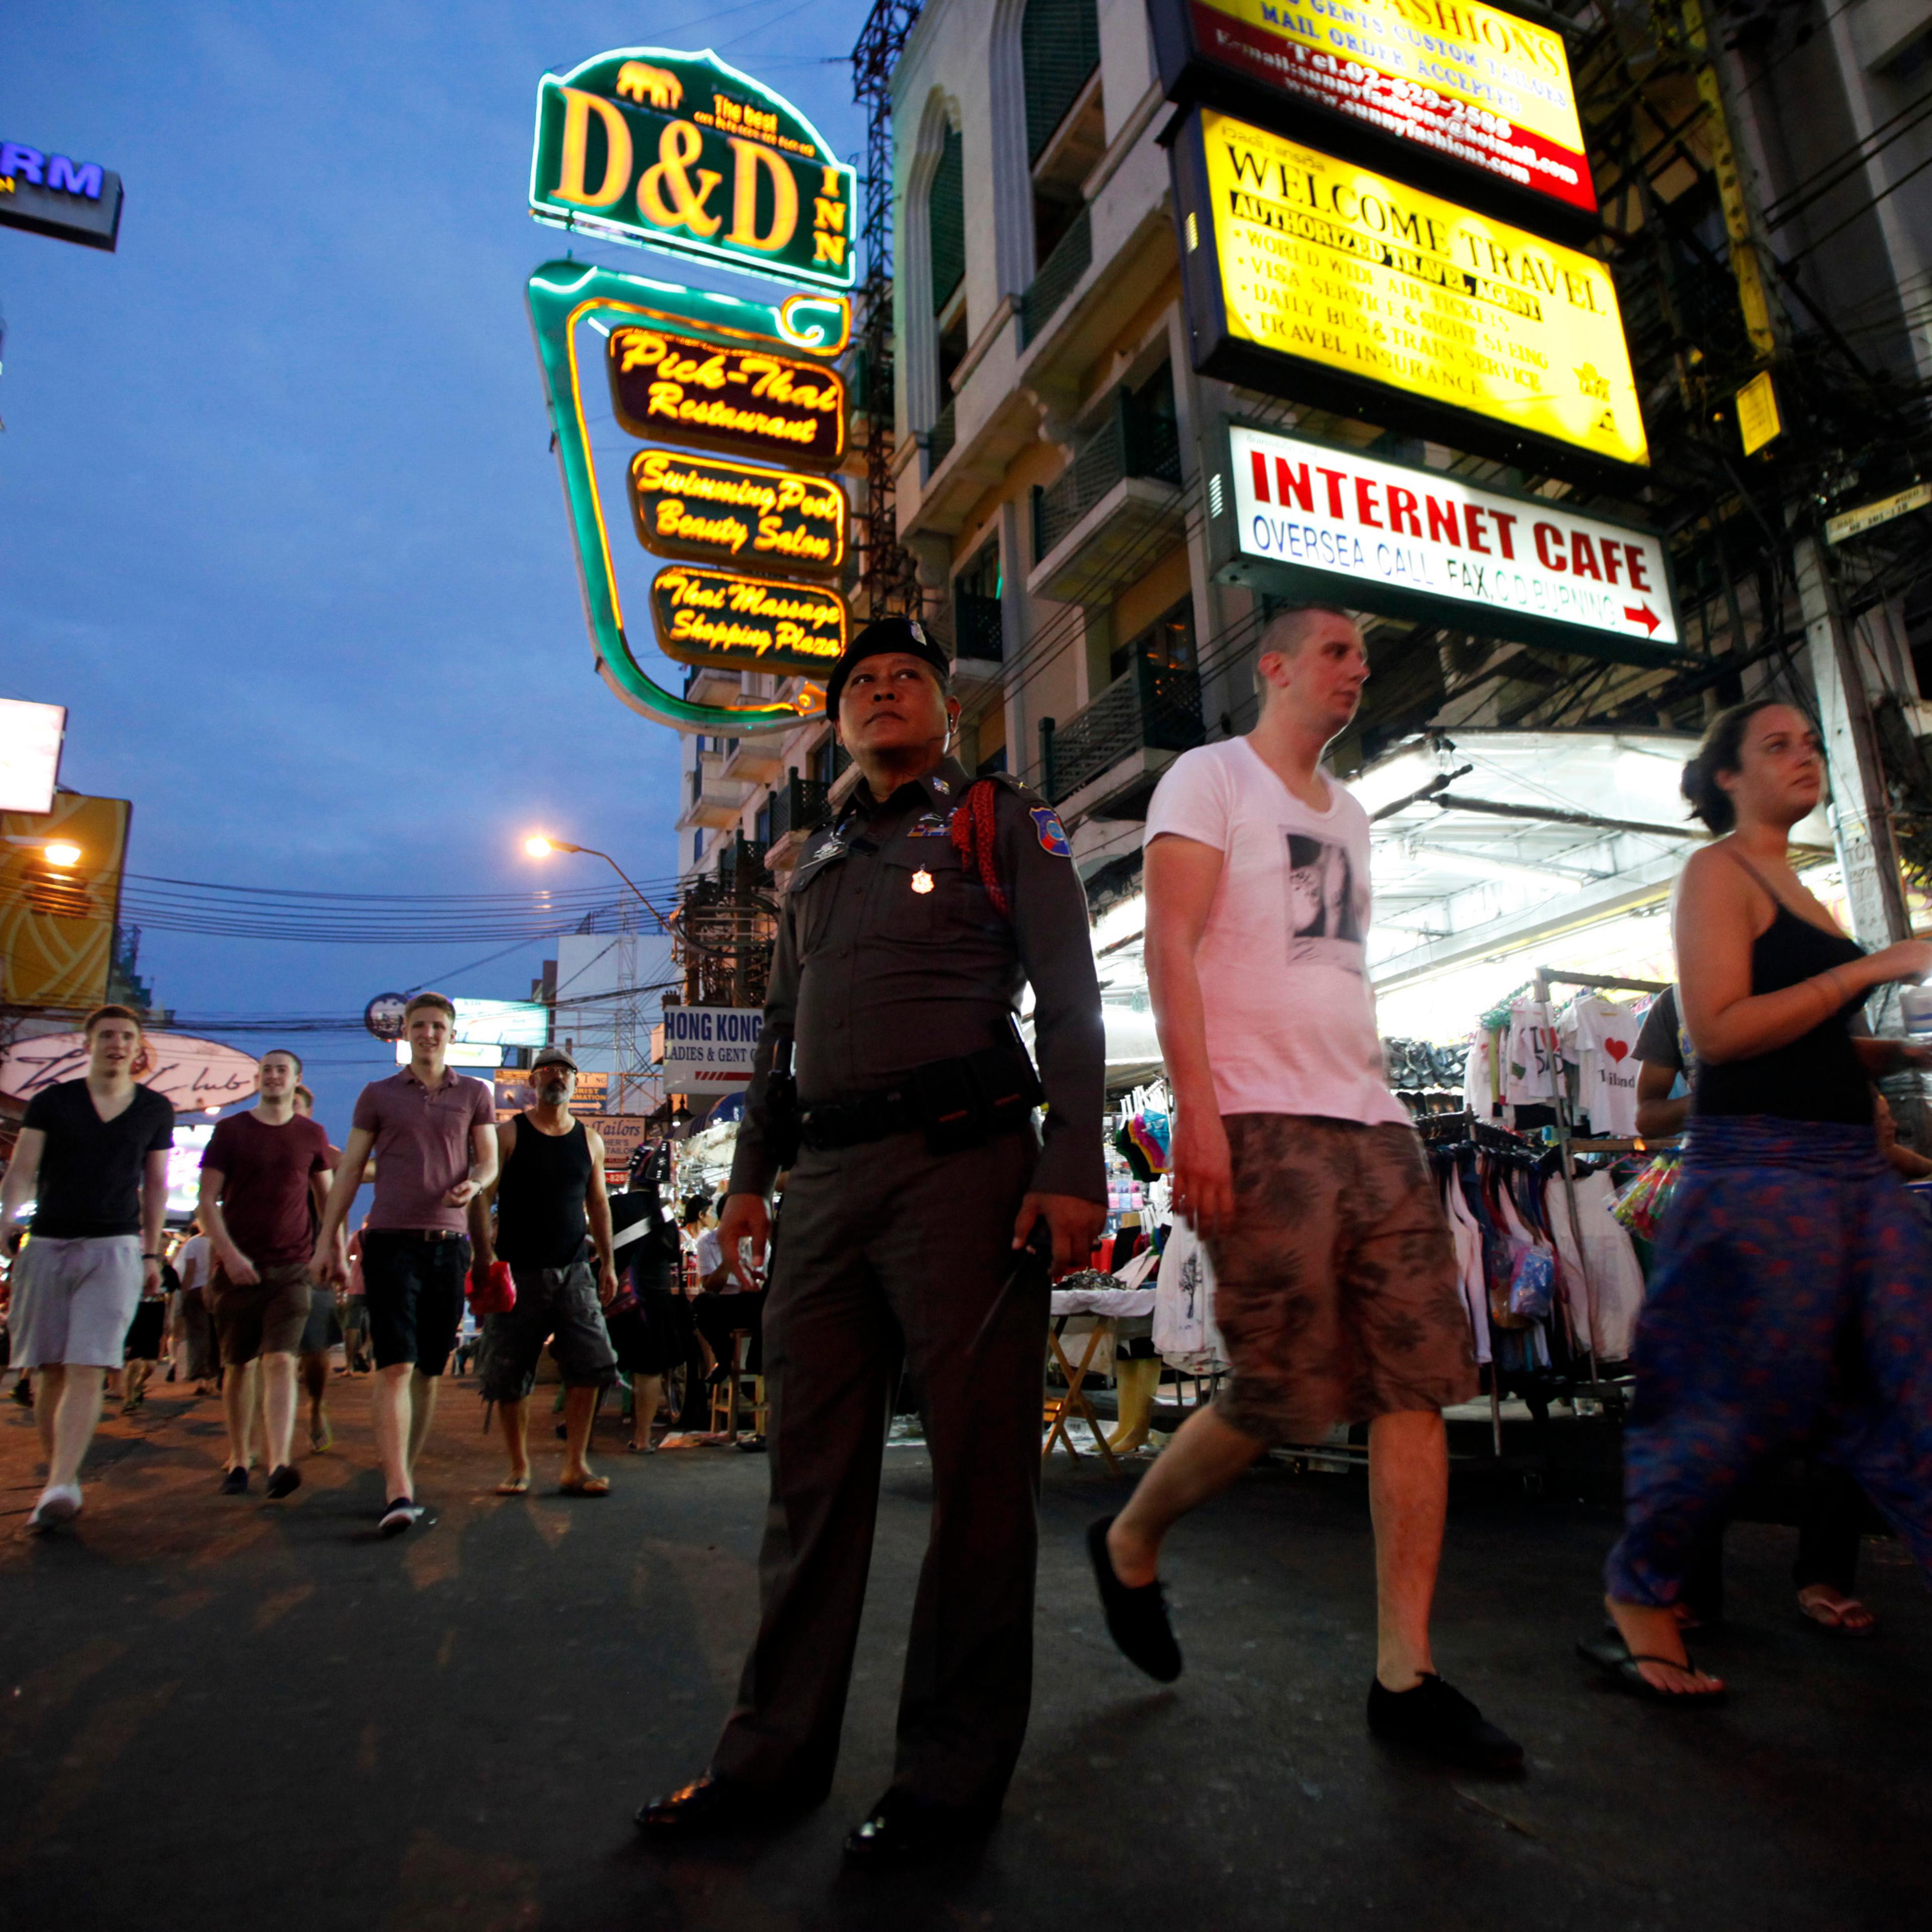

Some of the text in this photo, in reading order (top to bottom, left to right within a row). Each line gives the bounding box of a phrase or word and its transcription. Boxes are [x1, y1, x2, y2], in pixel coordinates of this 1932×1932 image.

[1261, 2, 1521, 113] MAIL ORDER ACCEPTED
[1311, 0, 1385, 34] GENTS
[1393, 24, 1479, 69] CUSTOM
[1364, 0, 1560, 76] SHIONS
[713, 94, 742, 124] The
[743, 104, 778, 134] best
[0, 140, 104, 200] RM
[547, 87, 800, 253] D&D
[811, 165, 848, 269] INN
[1224, 141, 1606, 316] WELCOME TRAVEL
[1234, 193, 1543, 321] AUTHORIZED TRAVEL AGENT
[1246, 228, 1509, 332] WORLD WIDE AIR TICKETS
[1251, 256, 1549, 370] VISA SERVICE & SIGHT SEEING
[1254, 283, 1541, 392] DAILY BUS & TRAIN SERVICE
[620, 334, 839, 412] Pick-Thai
[1260, 312, 1482, 397] TRAVEL INSURANCE
[647, 381, 819, 444] Restaurant
[637, 456, 838, 522] Swimming Pool
[1250, 450, 1652, 593] INTERNET CAFE
[656, 498, 831, 560] Beauty Salon
[1252, 514, 1367, 572] OVERSEA
[1377, 543, 1434, 585] CALL
[663, 576, 841, 630] Thai Massage
[670, 609, 842, 658] Shopping Plaza
[664, 1012, 763, 1042] HONG KONG
[664, 1045, 704, 1061] LADIES
[707, 1047, 714, 1062] &
[718, 1049, 747, 1063] GENT
[1598, 1069, 1635, 1089] Tiland
[592, 1120, 640, 1137] Tailors
